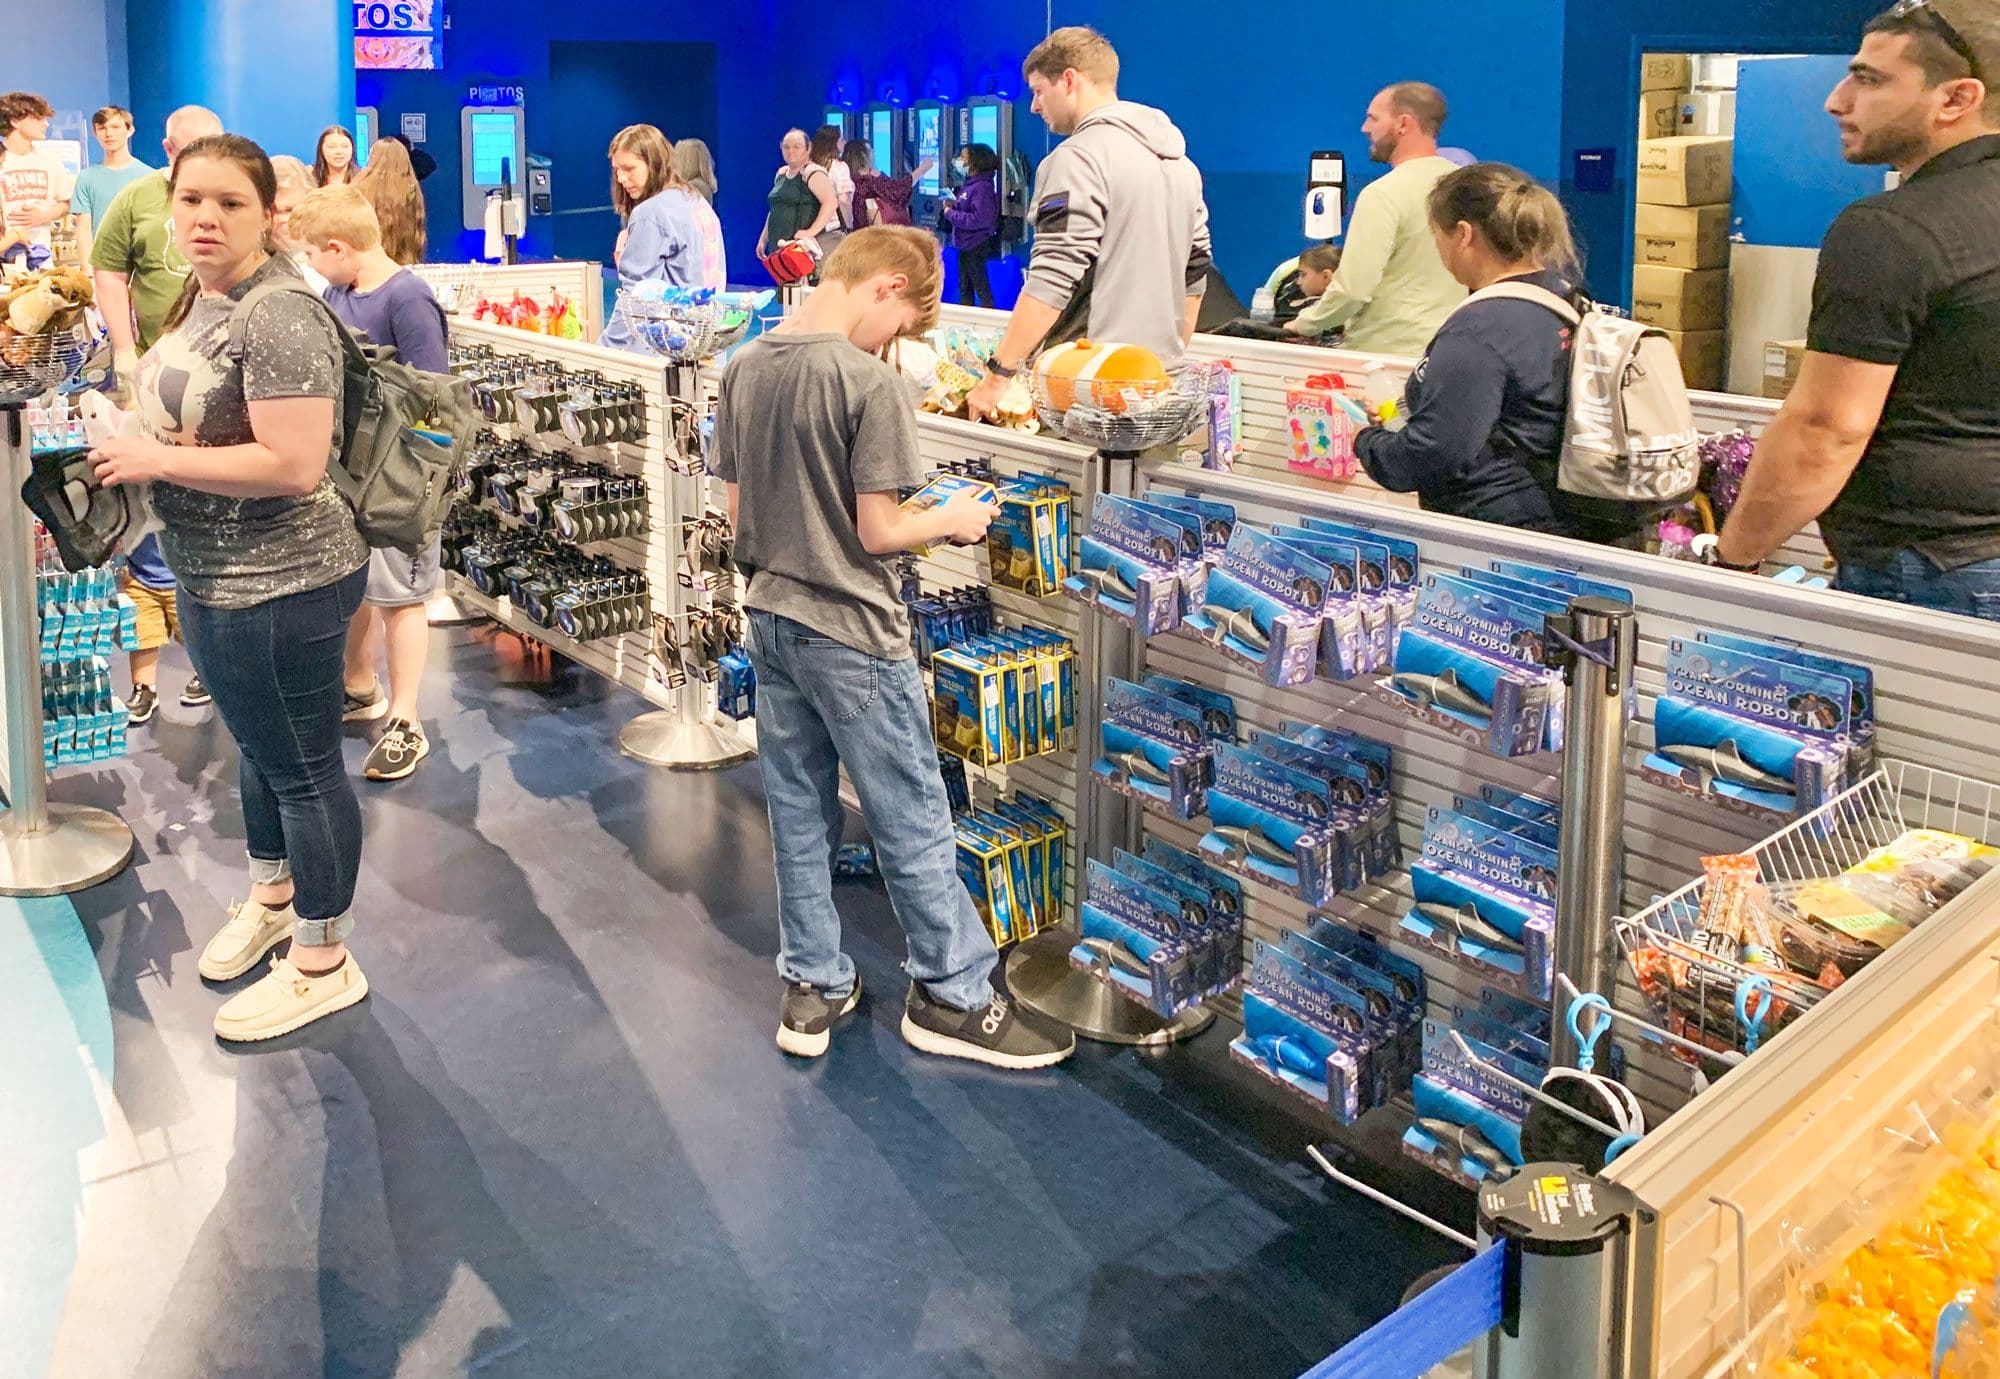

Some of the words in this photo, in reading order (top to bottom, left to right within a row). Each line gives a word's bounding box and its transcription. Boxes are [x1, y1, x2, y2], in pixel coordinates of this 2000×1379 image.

[470, 87, 524, 100] PTOS
[1092, 524, 1121, 543] OCEAN
[1124, 537, 1157, 558] ROBOT
[1226, 557, 1259, 581] OCEAN
[1261, 576, 1300, 602] ROBOT
[1420, 613, 1465, 639] OCEAN
[1468, 633, 1523, 658] ROBOT
[1422, 600, 1510, 638] TRANSFORMING
[1672, 665, 1784, 704] TRANSORMING
[1672, 680, 1729, 706] OCEAN
[1735, 701, 1802, 725] ROBOT
[1146, 720, 1181, 739] ROBOT
[1219, 775, 1257, 795] OCEAN
[1261, 789, 1303, 813] ROBOT
[1426, 844, 1473, 871] OCEAN
[1479, 865, 1533, 891] ROBOT
[1429, 833, 1520, 872] TRANSFORMING
[1091, 890, 1123, 912] OCEAN
[1126, 906, 1160, 930] ROBOT
[1256, 974, 1294, 1000] OCEAN
[1298, 996, 1341, 1026] ROBOT
[1426, 1058, 1474, 1087] OCEAN
[1479, 1083, 1532, 1113] ROBOT
